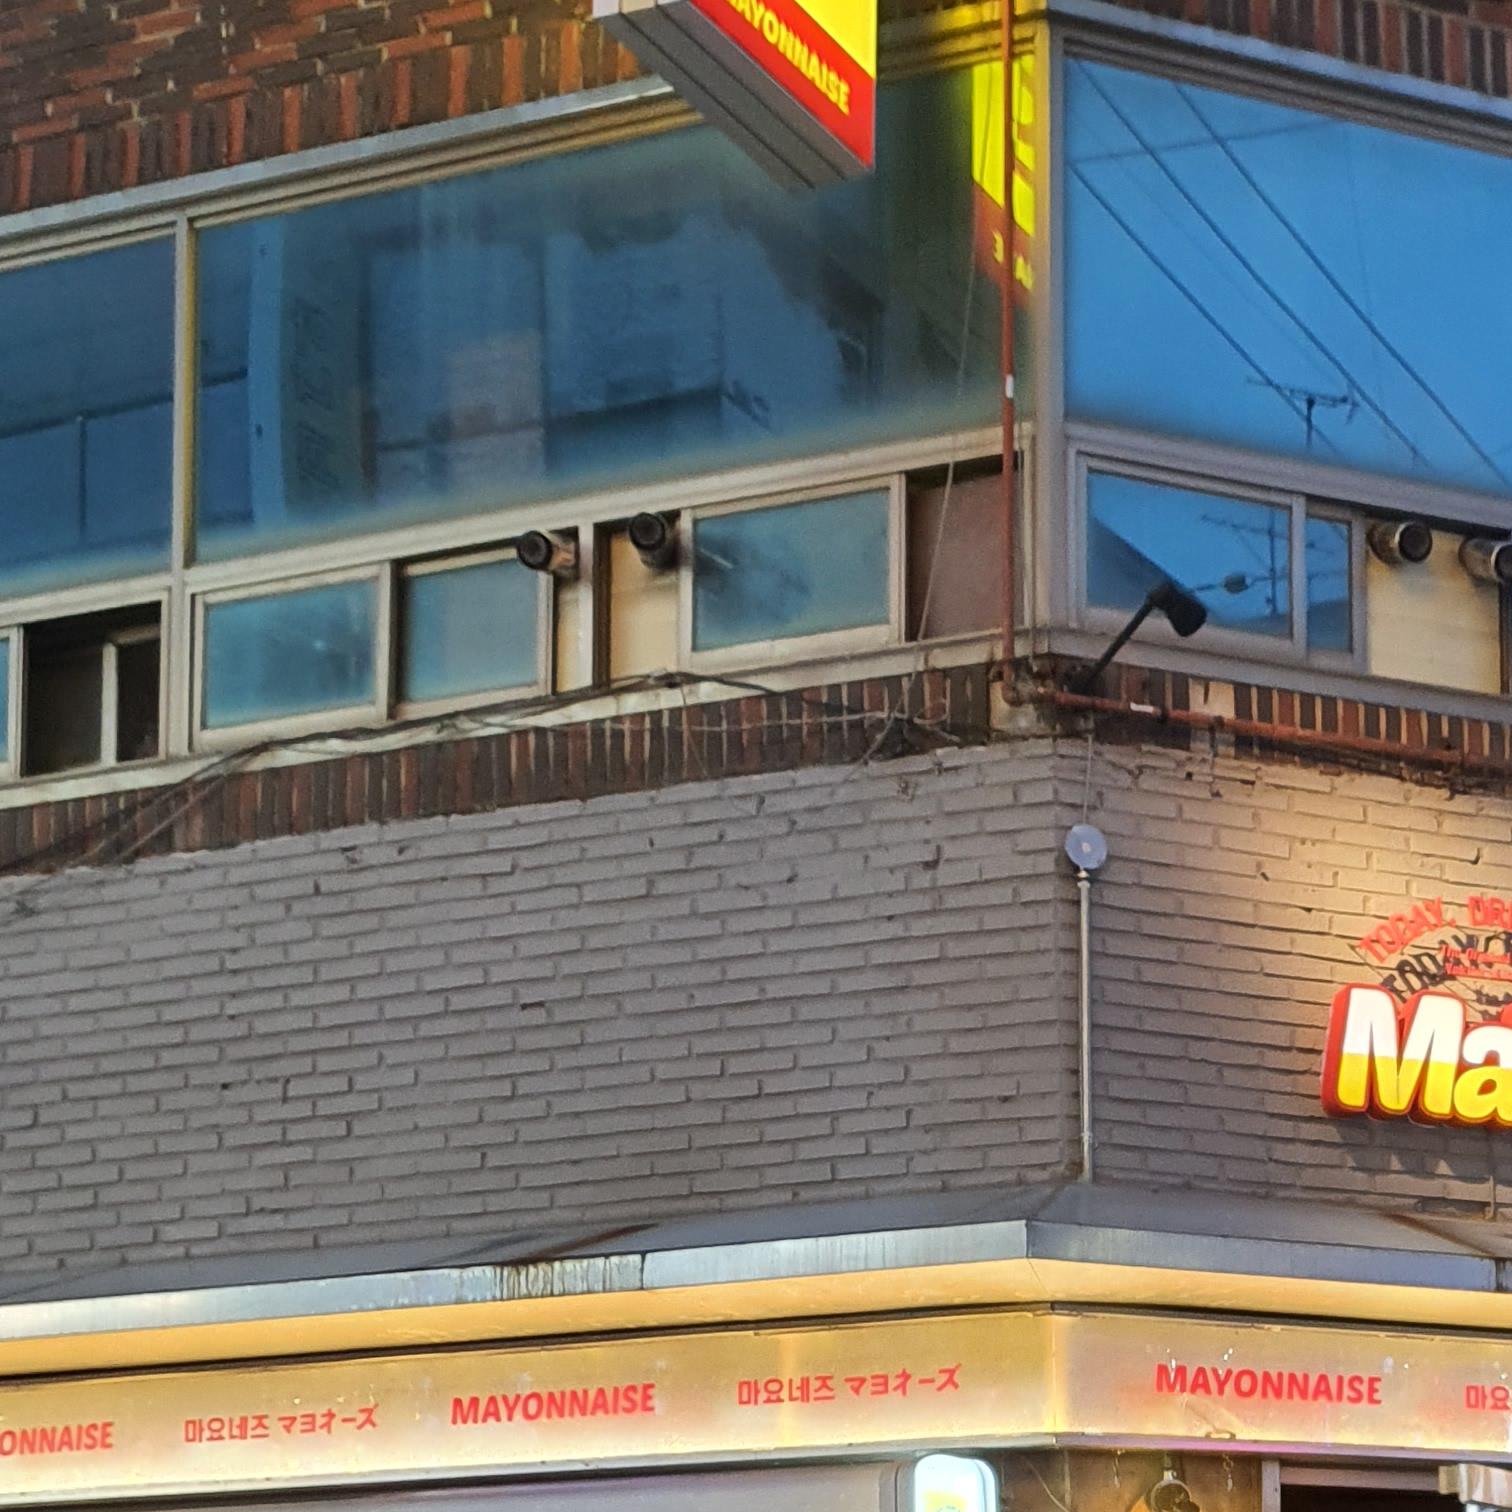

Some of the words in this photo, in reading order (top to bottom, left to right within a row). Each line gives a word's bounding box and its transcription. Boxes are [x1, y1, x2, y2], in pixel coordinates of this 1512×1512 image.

[725, 0, 850, 116] AYONNAISE
[738, 1375, 836, 1406] 마요네즈
[843, 1364, 961, 1397] マヨネーズ
[1155, 1364, 1382, 1405] MAYONNAISE
[278, 1405, 378, 1435] マヨネーズ
[451, 1383, 656, 1425] MAYONNAISE
[0, 1420, 114, 1457] ONNAISE
[183, 1414, 269, 1443] 마요네즈
